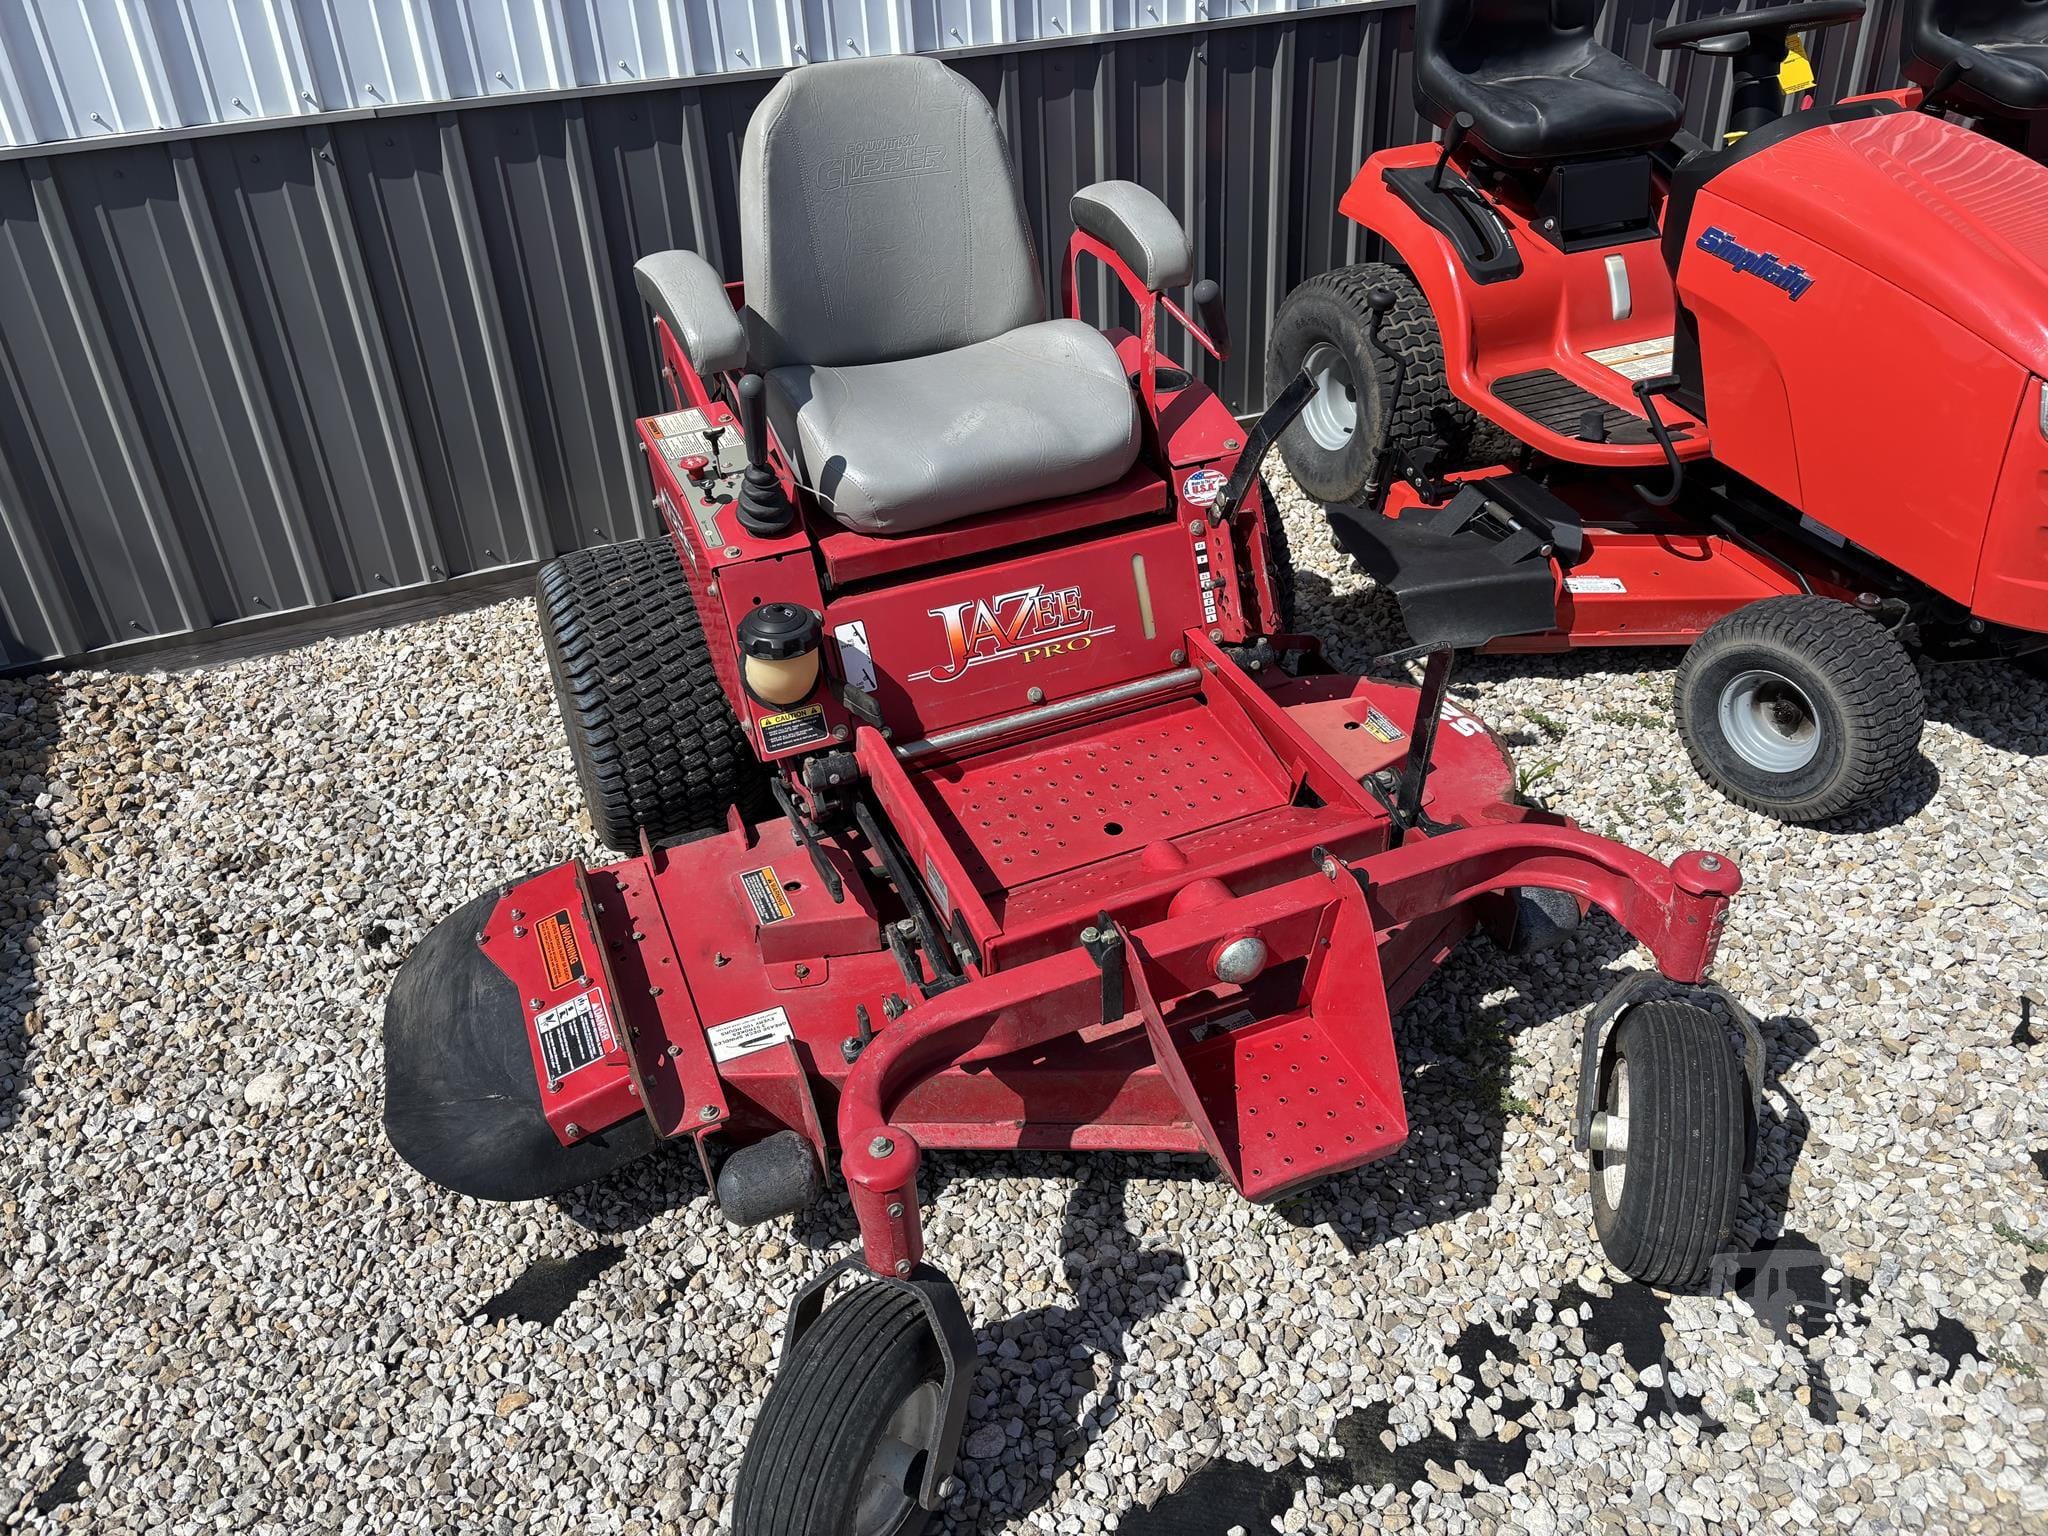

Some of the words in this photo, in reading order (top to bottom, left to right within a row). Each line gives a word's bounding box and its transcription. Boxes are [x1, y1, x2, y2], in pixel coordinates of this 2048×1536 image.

[844, 133, 920, 155] COUNTRY
[816, 144, 951, 192] CLIPPER
[1696, 226, 1816, 302] Simplicity
[1023, 636, 1092, 664] PRO
[775, 709, 807, 723] CAUTION
[770, 879, 786, 907] WARNING
[560, 926, 579, 965] WARNING
[594, 1008, 609, 1042] DANGER
[720, 1027, 742, 1037] HOURS
[745, 1029, 762, 1037] DECK
